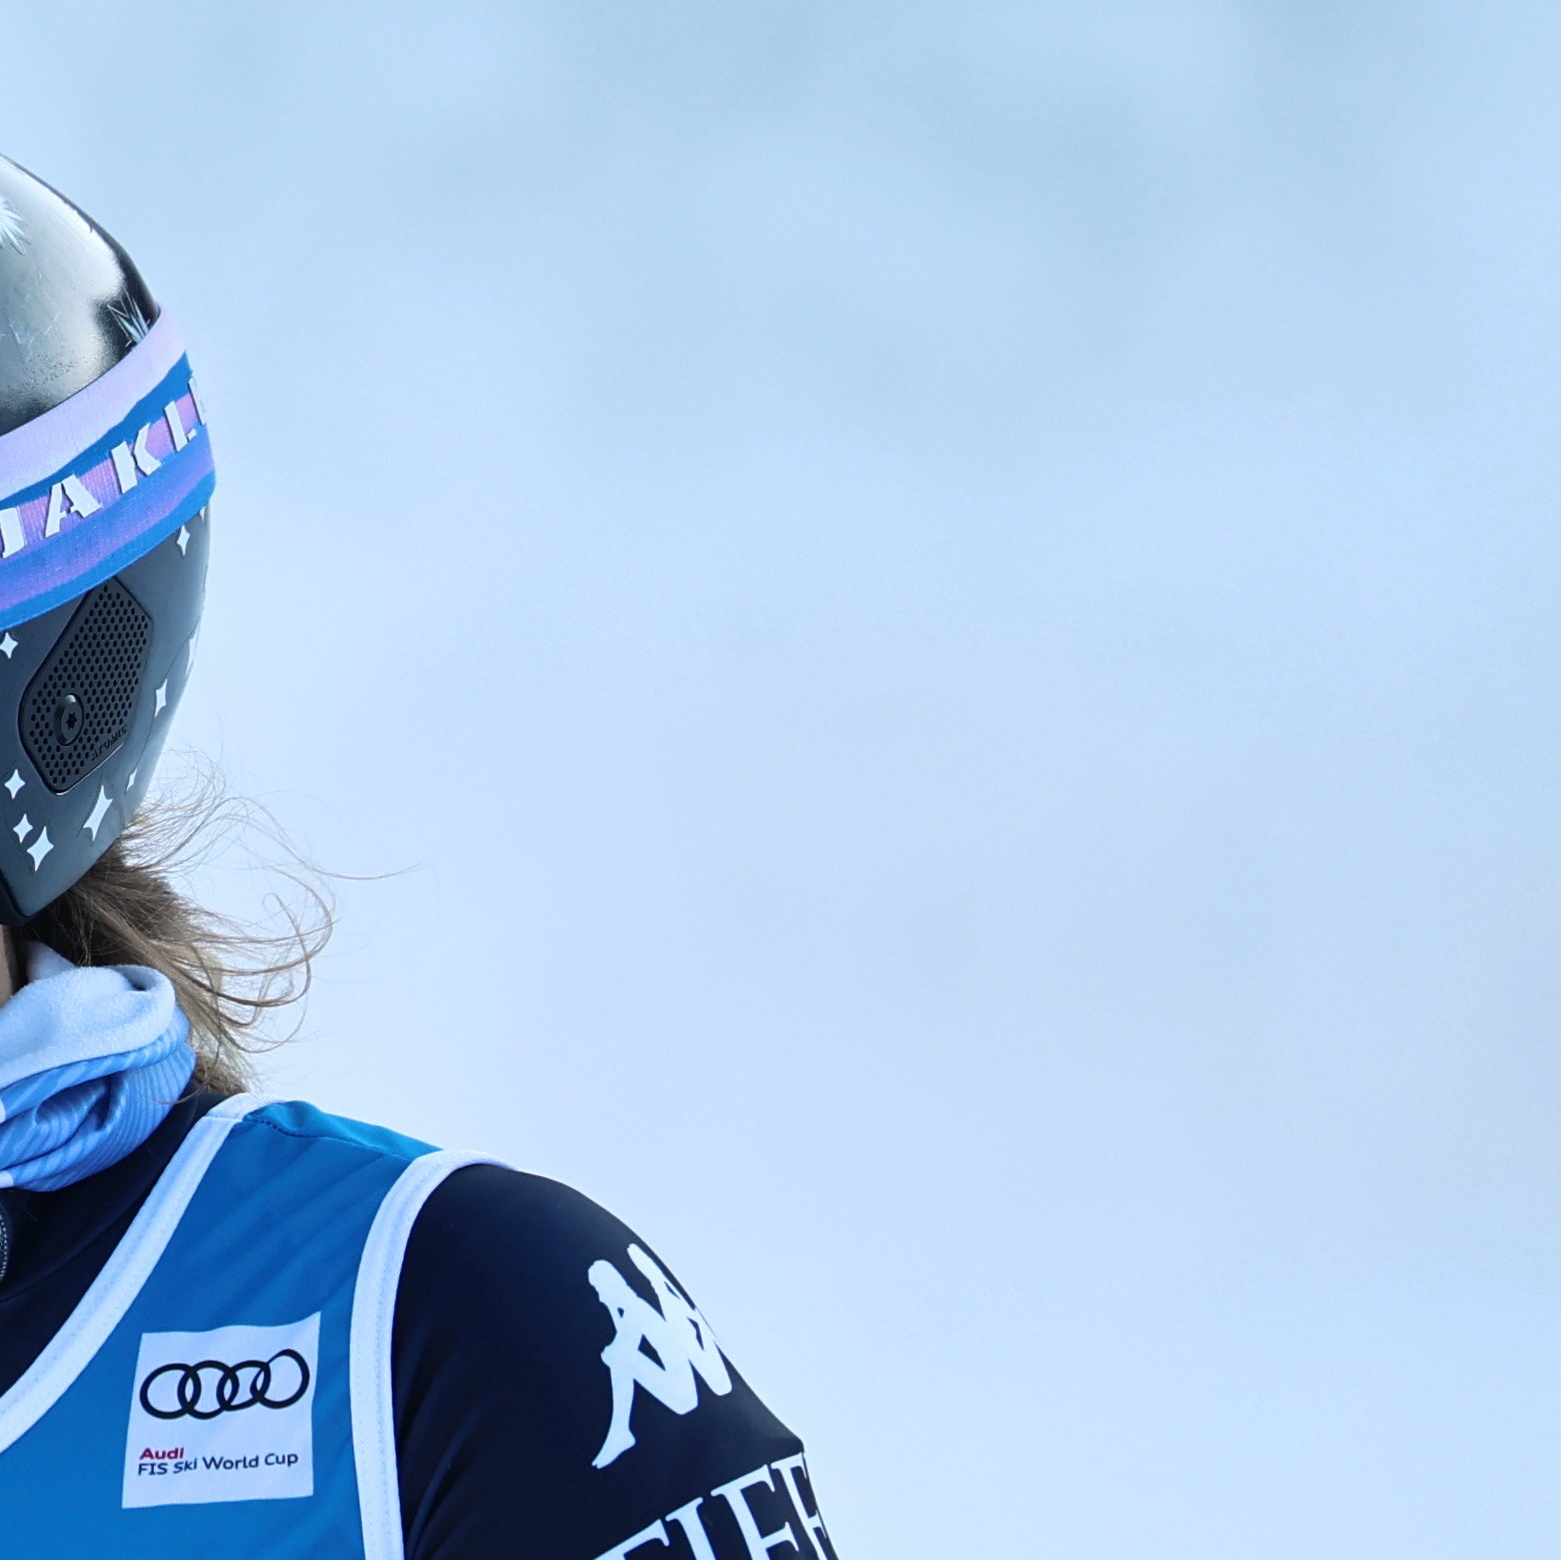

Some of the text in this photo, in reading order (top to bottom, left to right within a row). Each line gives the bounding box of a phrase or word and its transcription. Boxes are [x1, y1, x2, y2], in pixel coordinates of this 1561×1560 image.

[139, 1447, 185, 1461] Audi
[137, 1452, 299, 1476] FIS Ski World Cup
